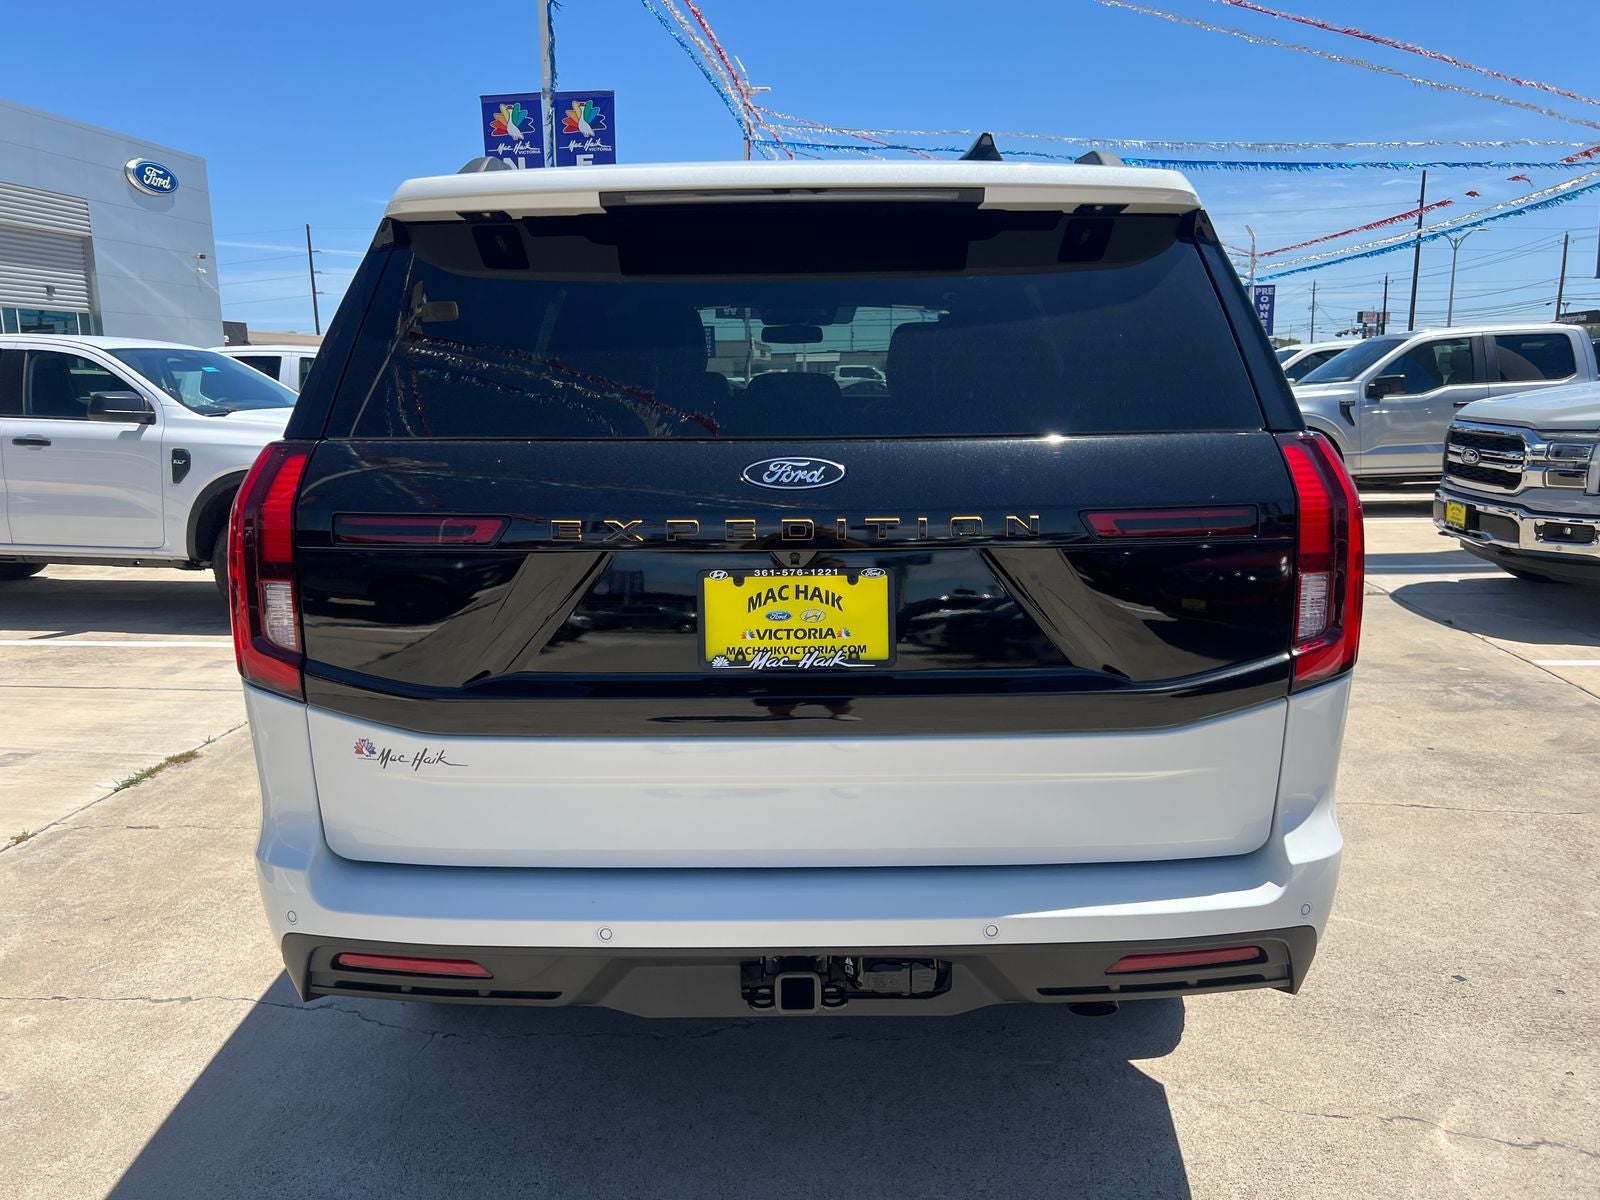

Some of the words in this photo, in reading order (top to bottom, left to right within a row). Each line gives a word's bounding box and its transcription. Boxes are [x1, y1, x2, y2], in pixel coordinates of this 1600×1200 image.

[143, 166, 171, 189] Ford
[1255, 287, 1275, 296] PRE
[1259, 295, 1270, 327] OWNE
[763, 461, 826, 483] Ford
[550, 514, 1040, 542] EXPEDITION
[754, 568, 839, 577] 361-576-1221
[747, 584, 790, 614] MAC
[795, 584, 844, 613] HAIK
[755, 628, 837, 641] VICTORIA
[725, 644, 867, 656] MACHAIKVICTORIACOM
[748, 651, 797, 670] Mac
[798, 650, 876, 670] Haik
[376, 748, 410, 769] Mac
[411, 747, 468, 772] Haik
